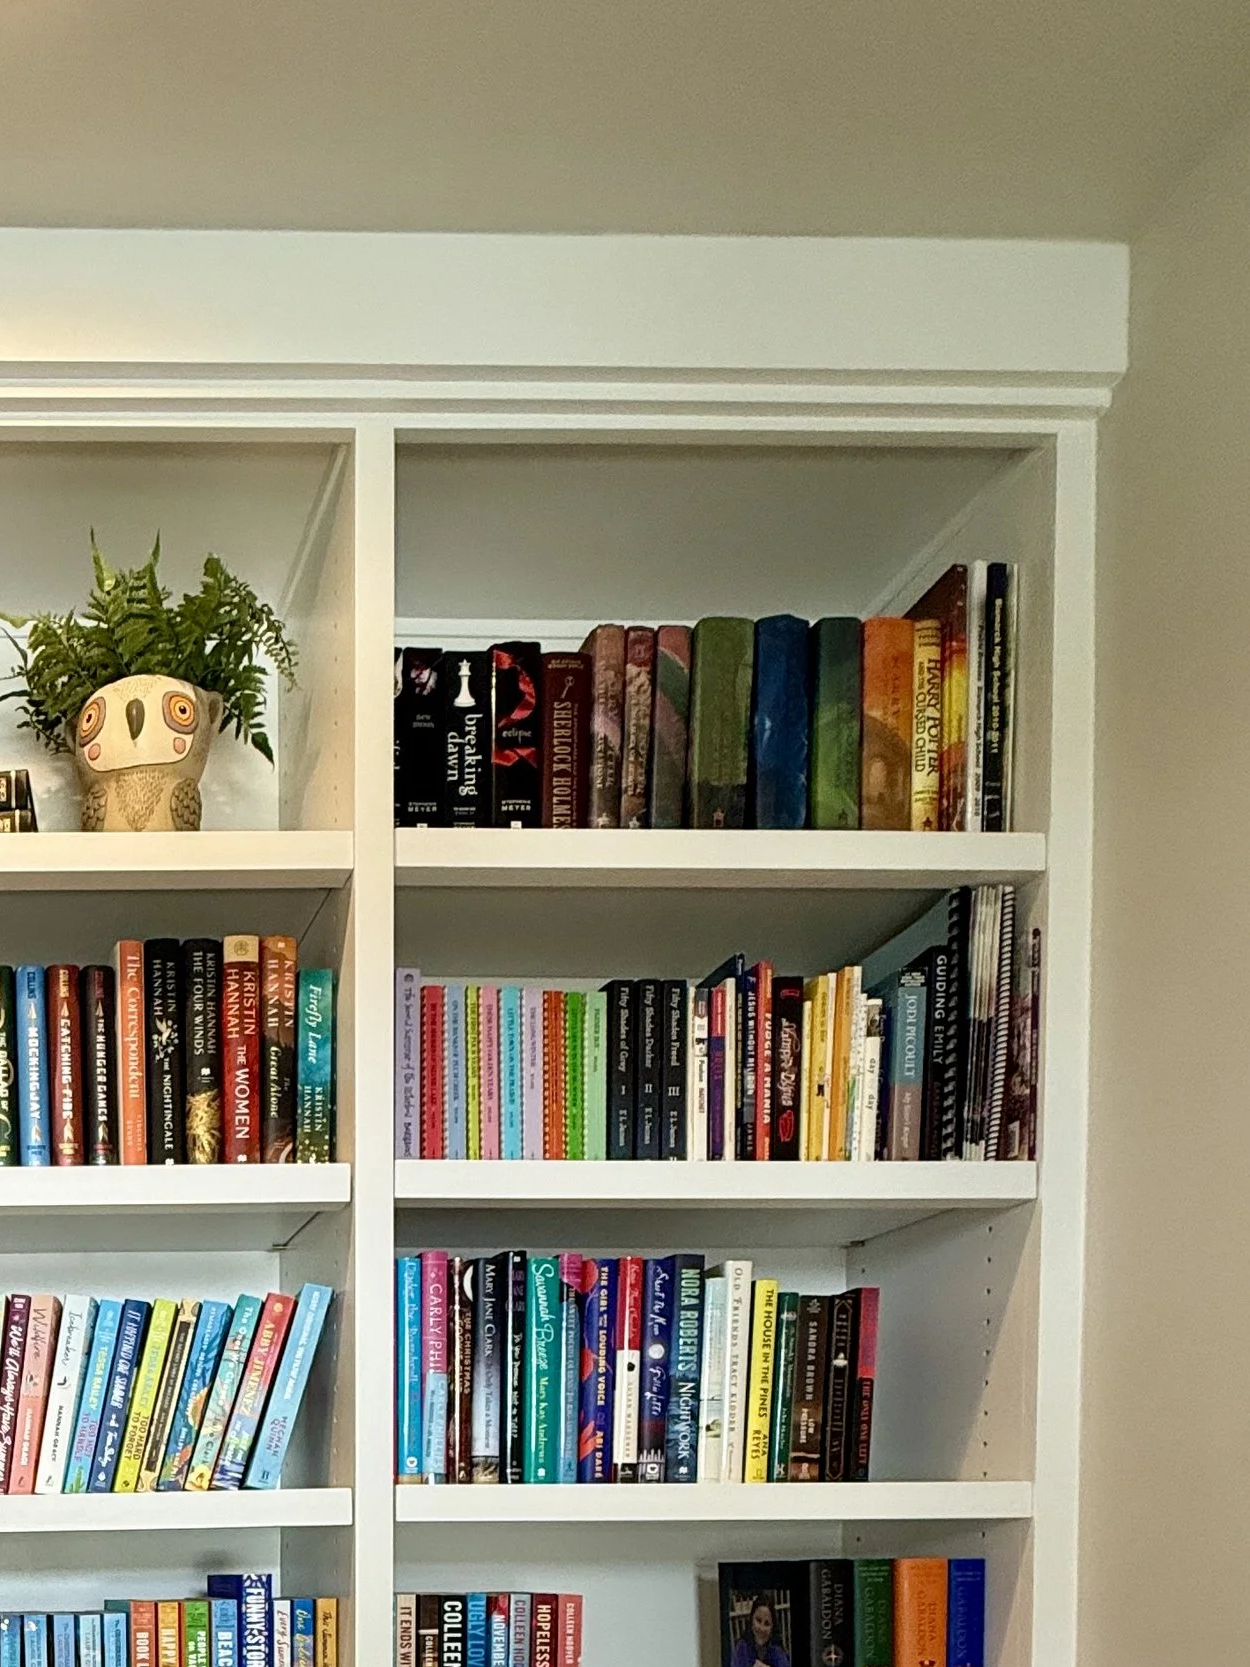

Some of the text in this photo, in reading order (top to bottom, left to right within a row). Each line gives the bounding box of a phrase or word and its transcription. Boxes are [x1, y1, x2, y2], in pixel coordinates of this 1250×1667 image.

[447, 732, 460, 782] dawn
[459, 714, 483, 796] breaking
[553, 702, 571, 771] SHERLOCK
[915, 693, 926, 772] CURSED CHILD
[927, 659, 940, 776] HARRY POTTER
[125, 954, 141, 1099] The Correspondent
[193, 951, 204, 1055] THE FOUR WINDS
[227, 969, 240, 1038] HANNAH
[244, 971, 255, 1035] KRISTIN
[305, 985, 322, 1064] Firefly Lane
[620, 1010, 628, 1036] Shades
[764, 1013, 772, 1057] FUDGE
[904, 995, 917, 1078] JODI PICOULT
[933, 955, 947, 1064] GUIDING EMILY
[29, 1027, 40, 1119] MOCKINGJAY
[97, 1035, 107, 1121] HUNGER GAMES
[236, 1045, 250, 1139] THE WOMEN
[764, 1063, 771, 1072] A
[163, 1075, 173, 1150] NIGHTINGALE
[532, 1264, 555, 1369] Savannah Breeze
[678, 1268, 700, 1371] NORA ROBERTS
[758, 1289, 774, 1417] THE HOUSE IN THE PINES
[678, 1382, 695, 1459] NIGHTWORK
[246, 1588, 265, 1634] FUNNY
[400, 1607, 410, 1618] IT
[400, 1620, 410, 1649] ENDS
